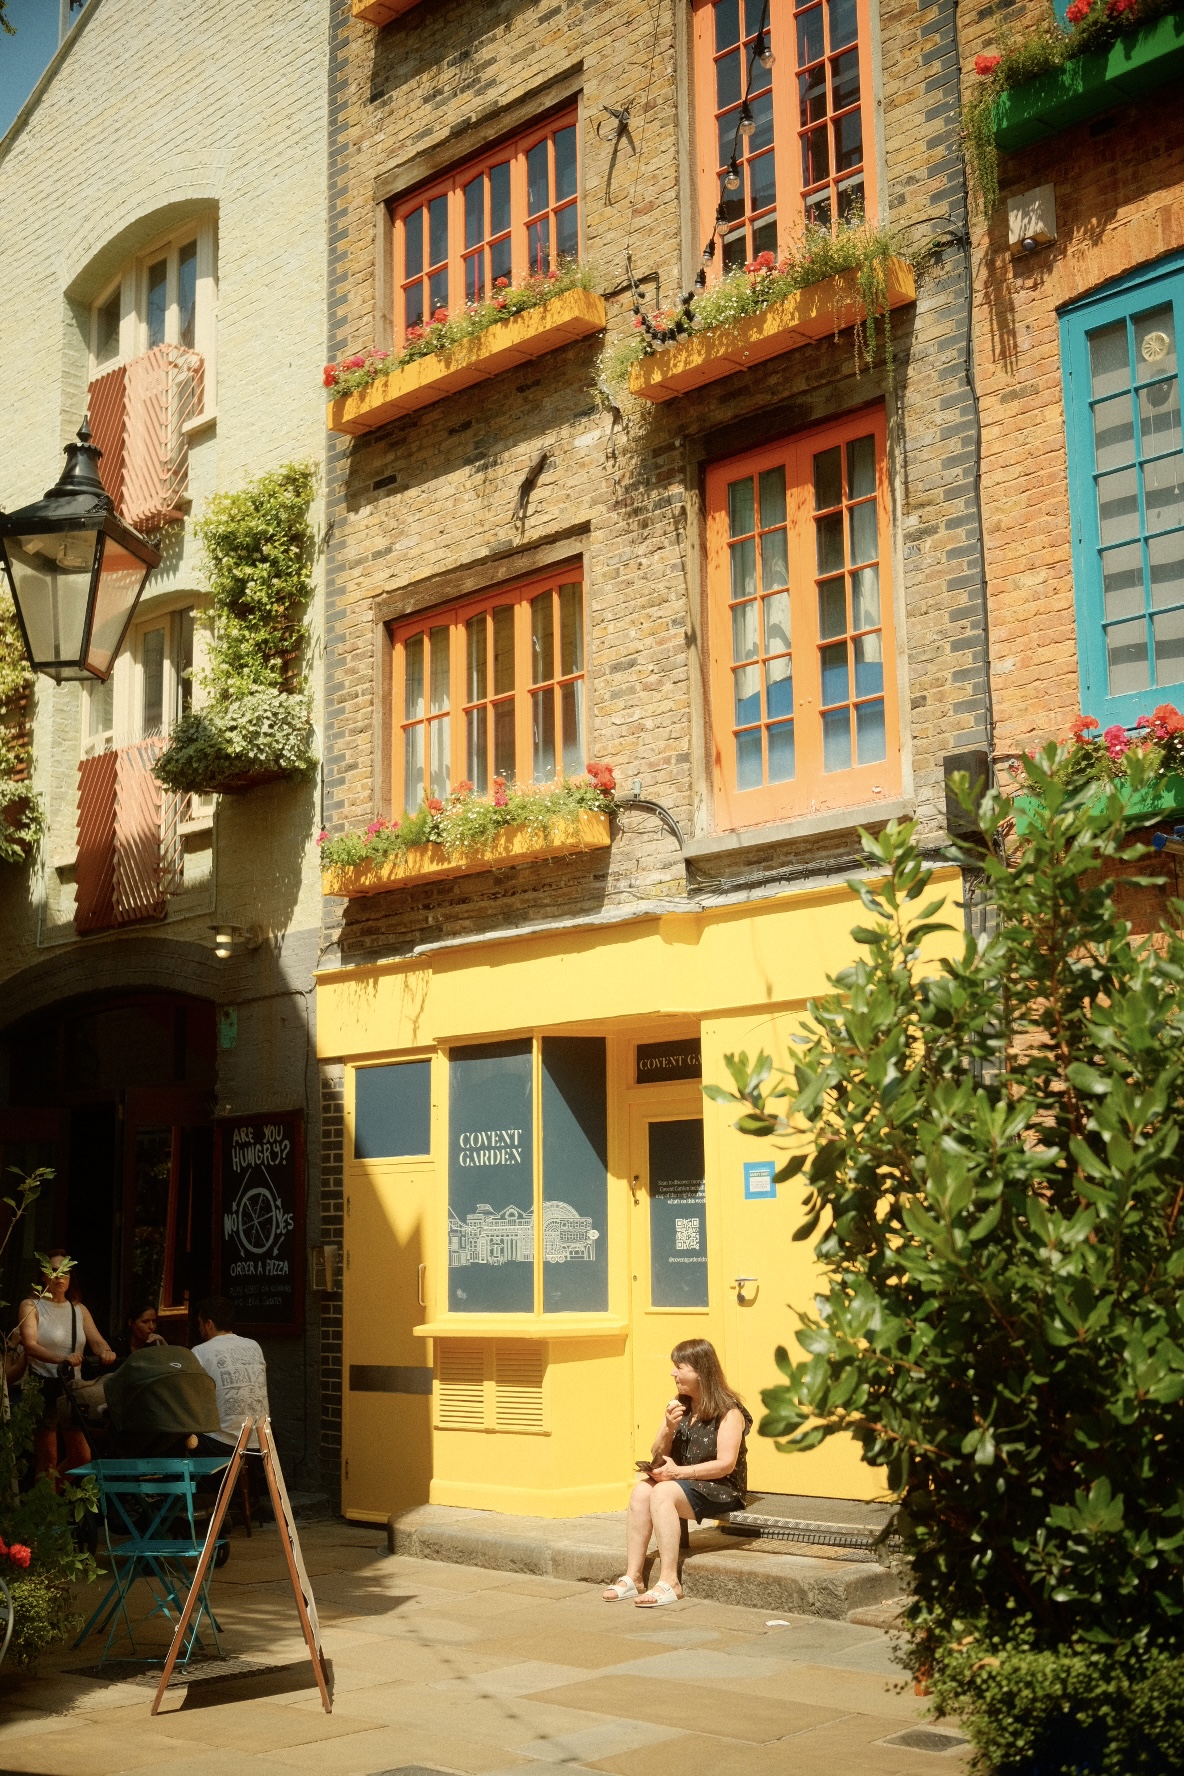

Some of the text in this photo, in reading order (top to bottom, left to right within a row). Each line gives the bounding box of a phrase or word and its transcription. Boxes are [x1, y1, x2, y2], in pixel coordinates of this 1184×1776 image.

[639, 1055, 685, 1070] COVENT
[232, 1124, 283, 1146] ARE YOU
[459, 1129, 522, 1148] COVENT
[231, 1139, 290, 1173] HUNGRY?
[459, 1148, 522, 1167] GARDEN
[223, 1212, 237, 1241] NO
[275, 1207, 294, 1236] YES
[231, 1259, 289, 1277] ORDER A PIZZA
